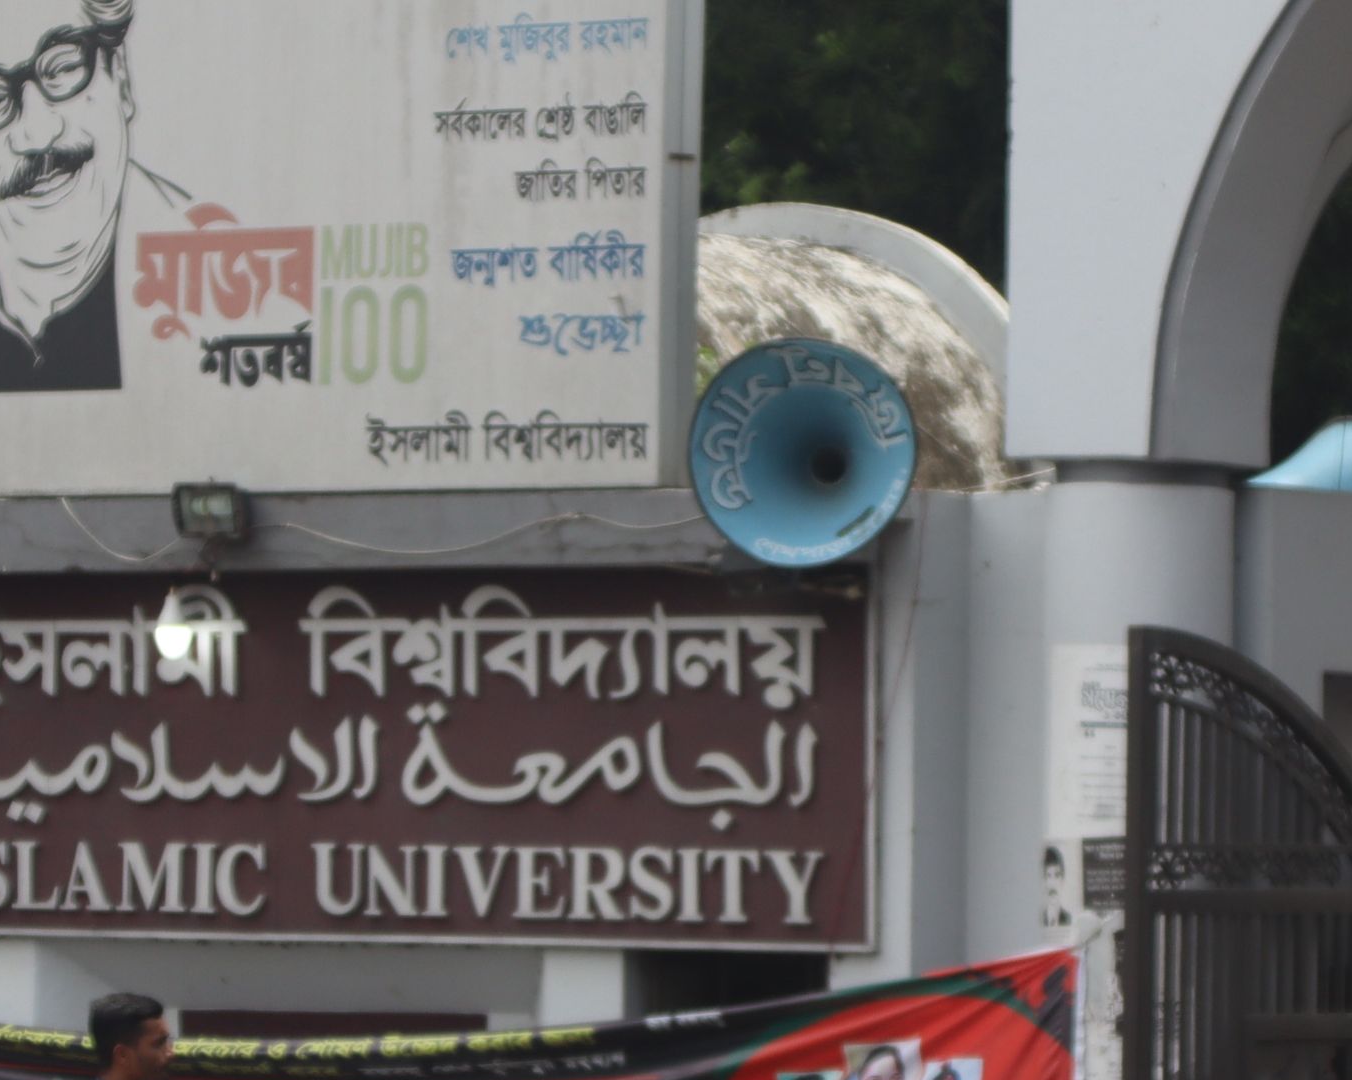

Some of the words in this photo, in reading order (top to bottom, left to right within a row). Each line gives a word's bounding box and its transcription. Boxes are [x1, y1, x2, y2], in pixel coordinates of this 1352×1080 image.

[446, 25, 489, 60] শেখ
[498, 12, 571, 63] মুজিবুর
[578, 17, 649, 54] রহমান
[433, 97, 527, 141] সর্বকালের
[582, 90, 648, 136] বাঙালি
[514, 158, 577, 205] জাতির
[584, 156, 647, 200] পিতার
[132, 202, 316, 341] মুজিব
[320, 221, 430, 279] MUJIB
[547, 229, 647, 282] বার্ষিকীর
[199, 319, 313, 388] শতবর্ষ
[317, 283, 429, 387] 100
[518, 311, 647, 356] শুভেচ্ছা
[365, 410, 473, 467] ইসলামী
[481, 409, 649, 463] বিশ্ববিদ্যালয়
[298, 585, 827, 708] বিশ্ববিদ্যালয়
[401, 700, 818, 831] الجامعة
[309, 841, 825, 925] UNIVERSITY
